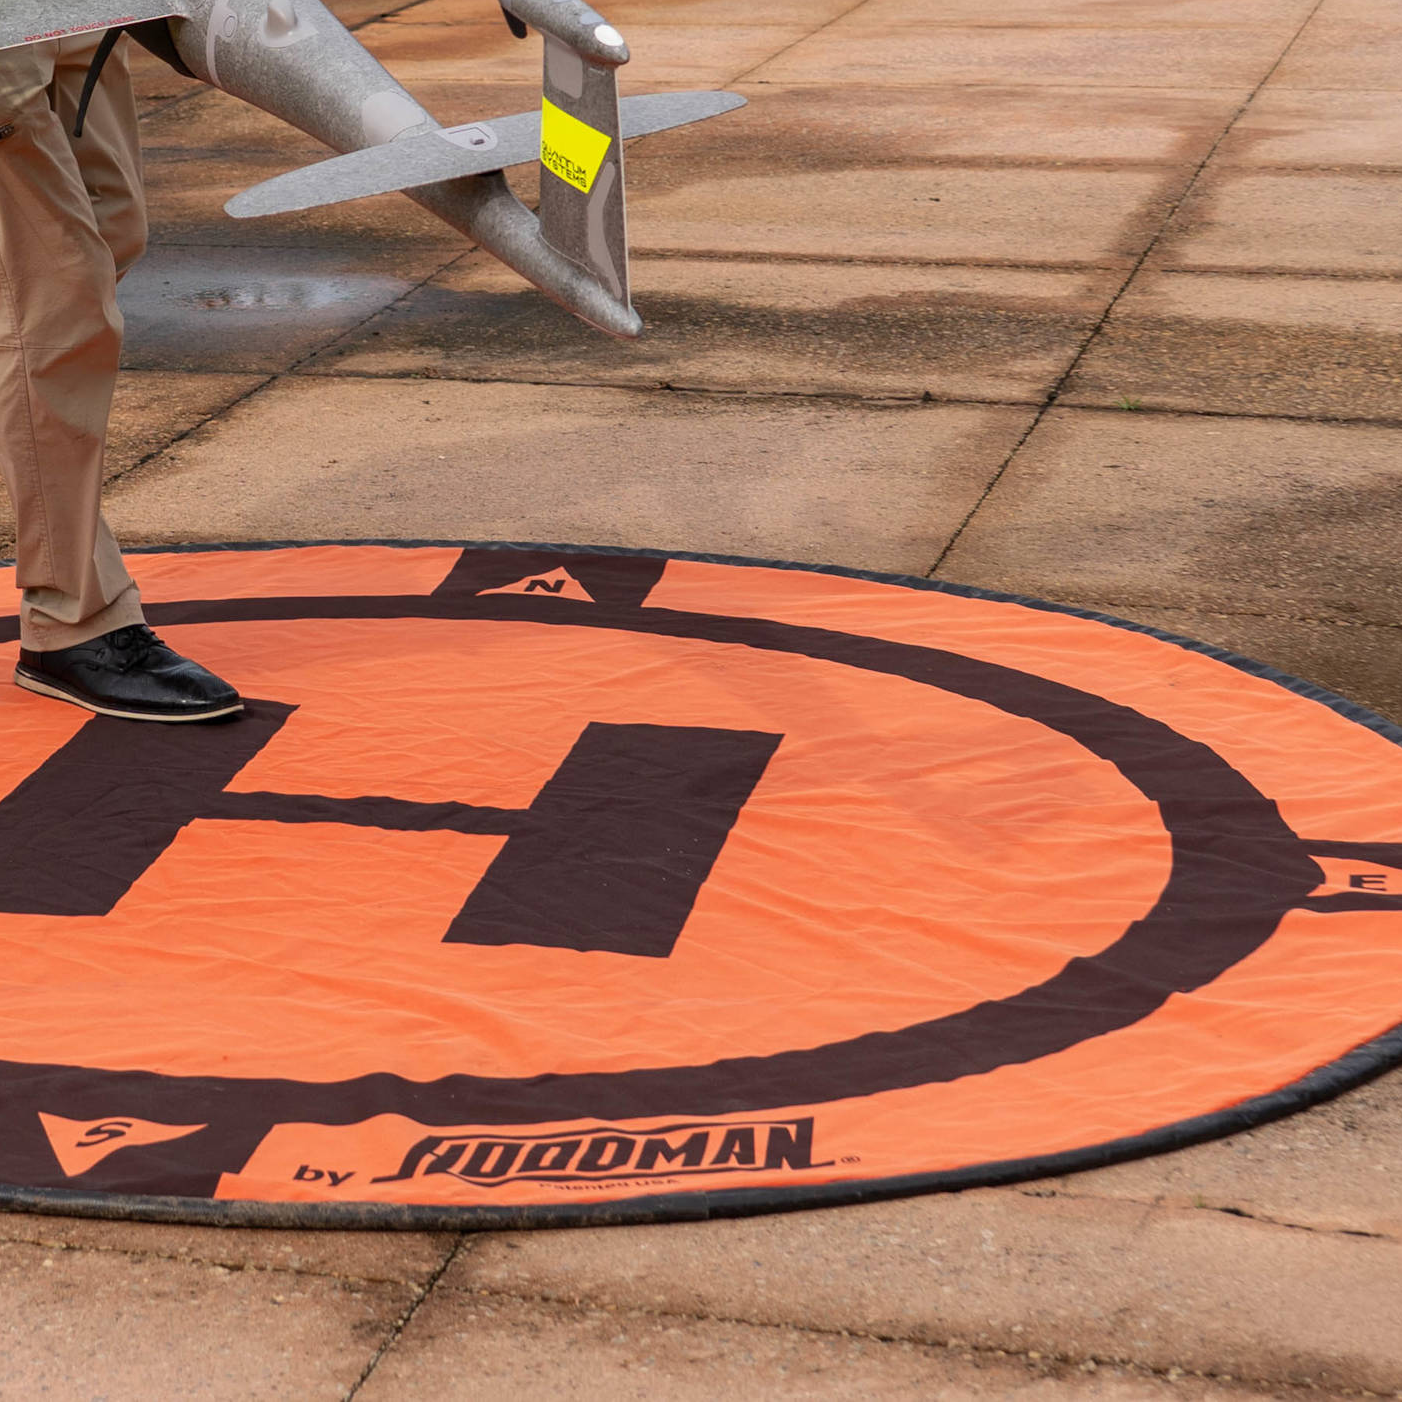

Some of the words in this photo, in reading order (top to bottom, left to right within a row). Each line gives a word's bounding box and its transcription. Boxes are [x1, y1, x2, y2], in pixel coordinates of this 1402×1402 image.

[24, 33, 42, 42] DO
[44, 28, 66, 38] NOT
[69, 21, 106, 33] TOUCH
[541, 140, 587, 178] QUANTUM
[541, 149, 587, 189] SYSTEMS
[523, 578, 566, 594] N
[1349, 873, 1388, 892] E
[75, 1121, 133, 1148] S
[292, 1164, 357, 1187] by
[370, 1116, 835, 1188] HOODMAN
